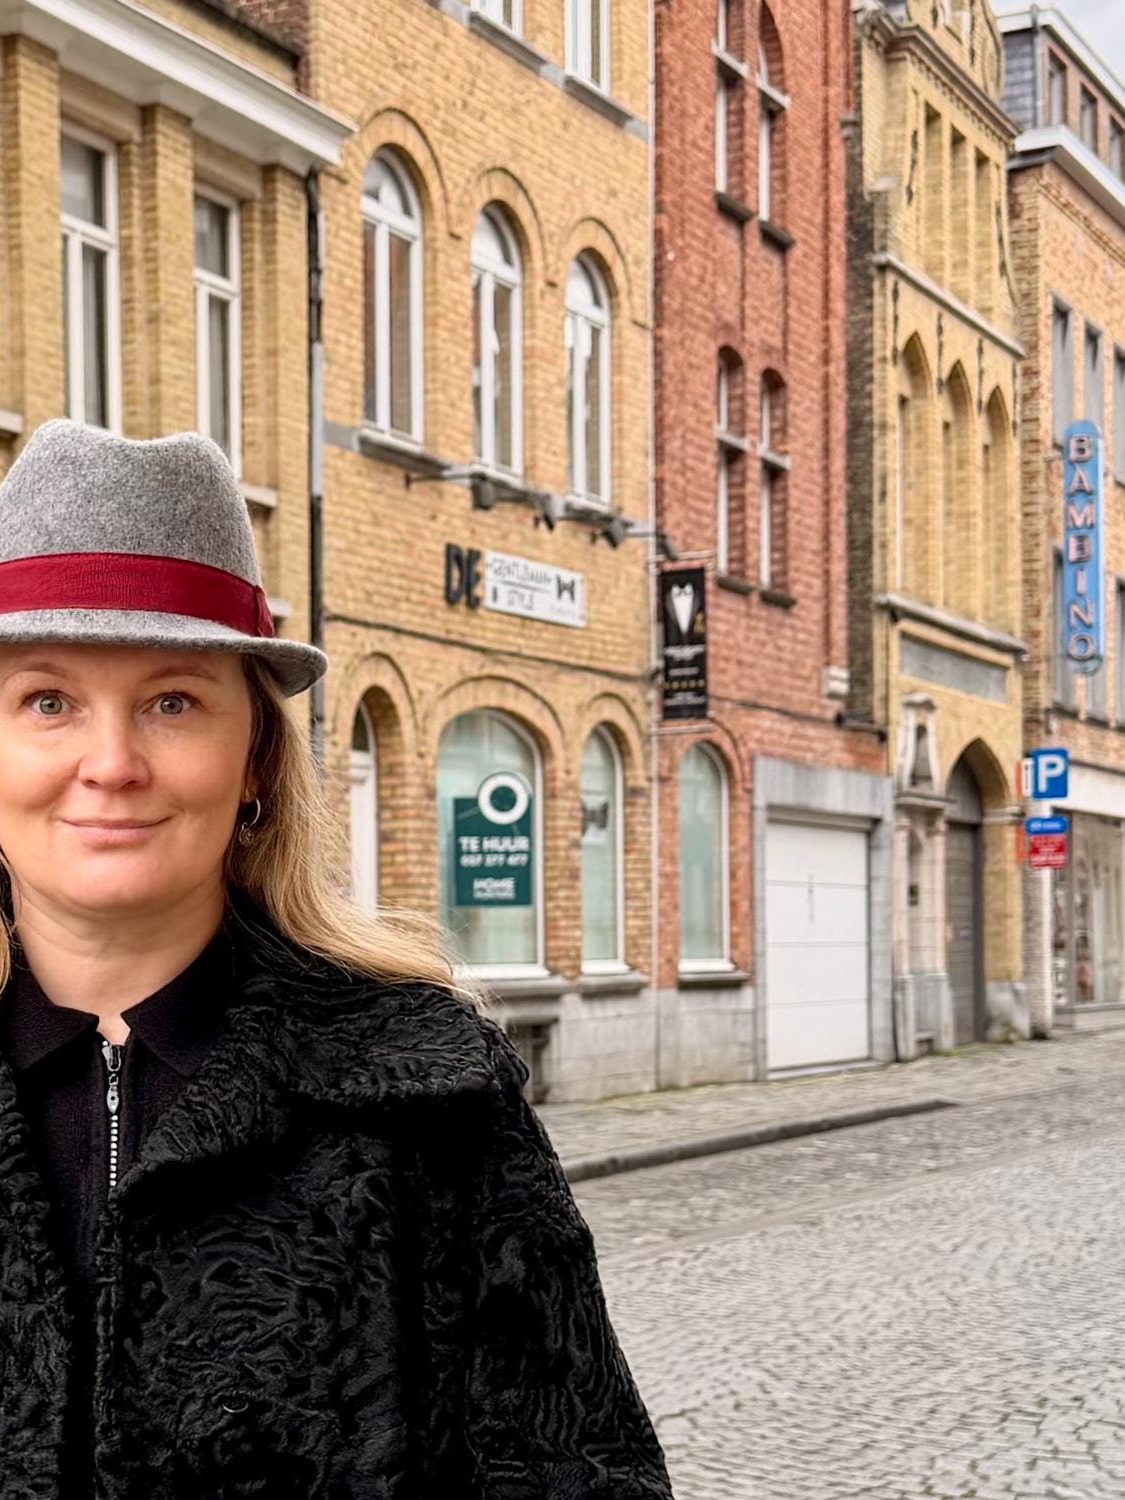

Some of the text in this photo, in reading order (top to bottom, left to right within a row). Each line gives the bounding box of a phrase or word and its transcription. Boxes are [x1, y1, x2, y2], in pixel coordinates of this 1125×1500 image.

[1066, 434, 1095, 661] BAMBINO
[444, 542, 481, 610] DE
[1038, 754, 1065, 793] P
[458, 835, 530, 853] TE HUUR
